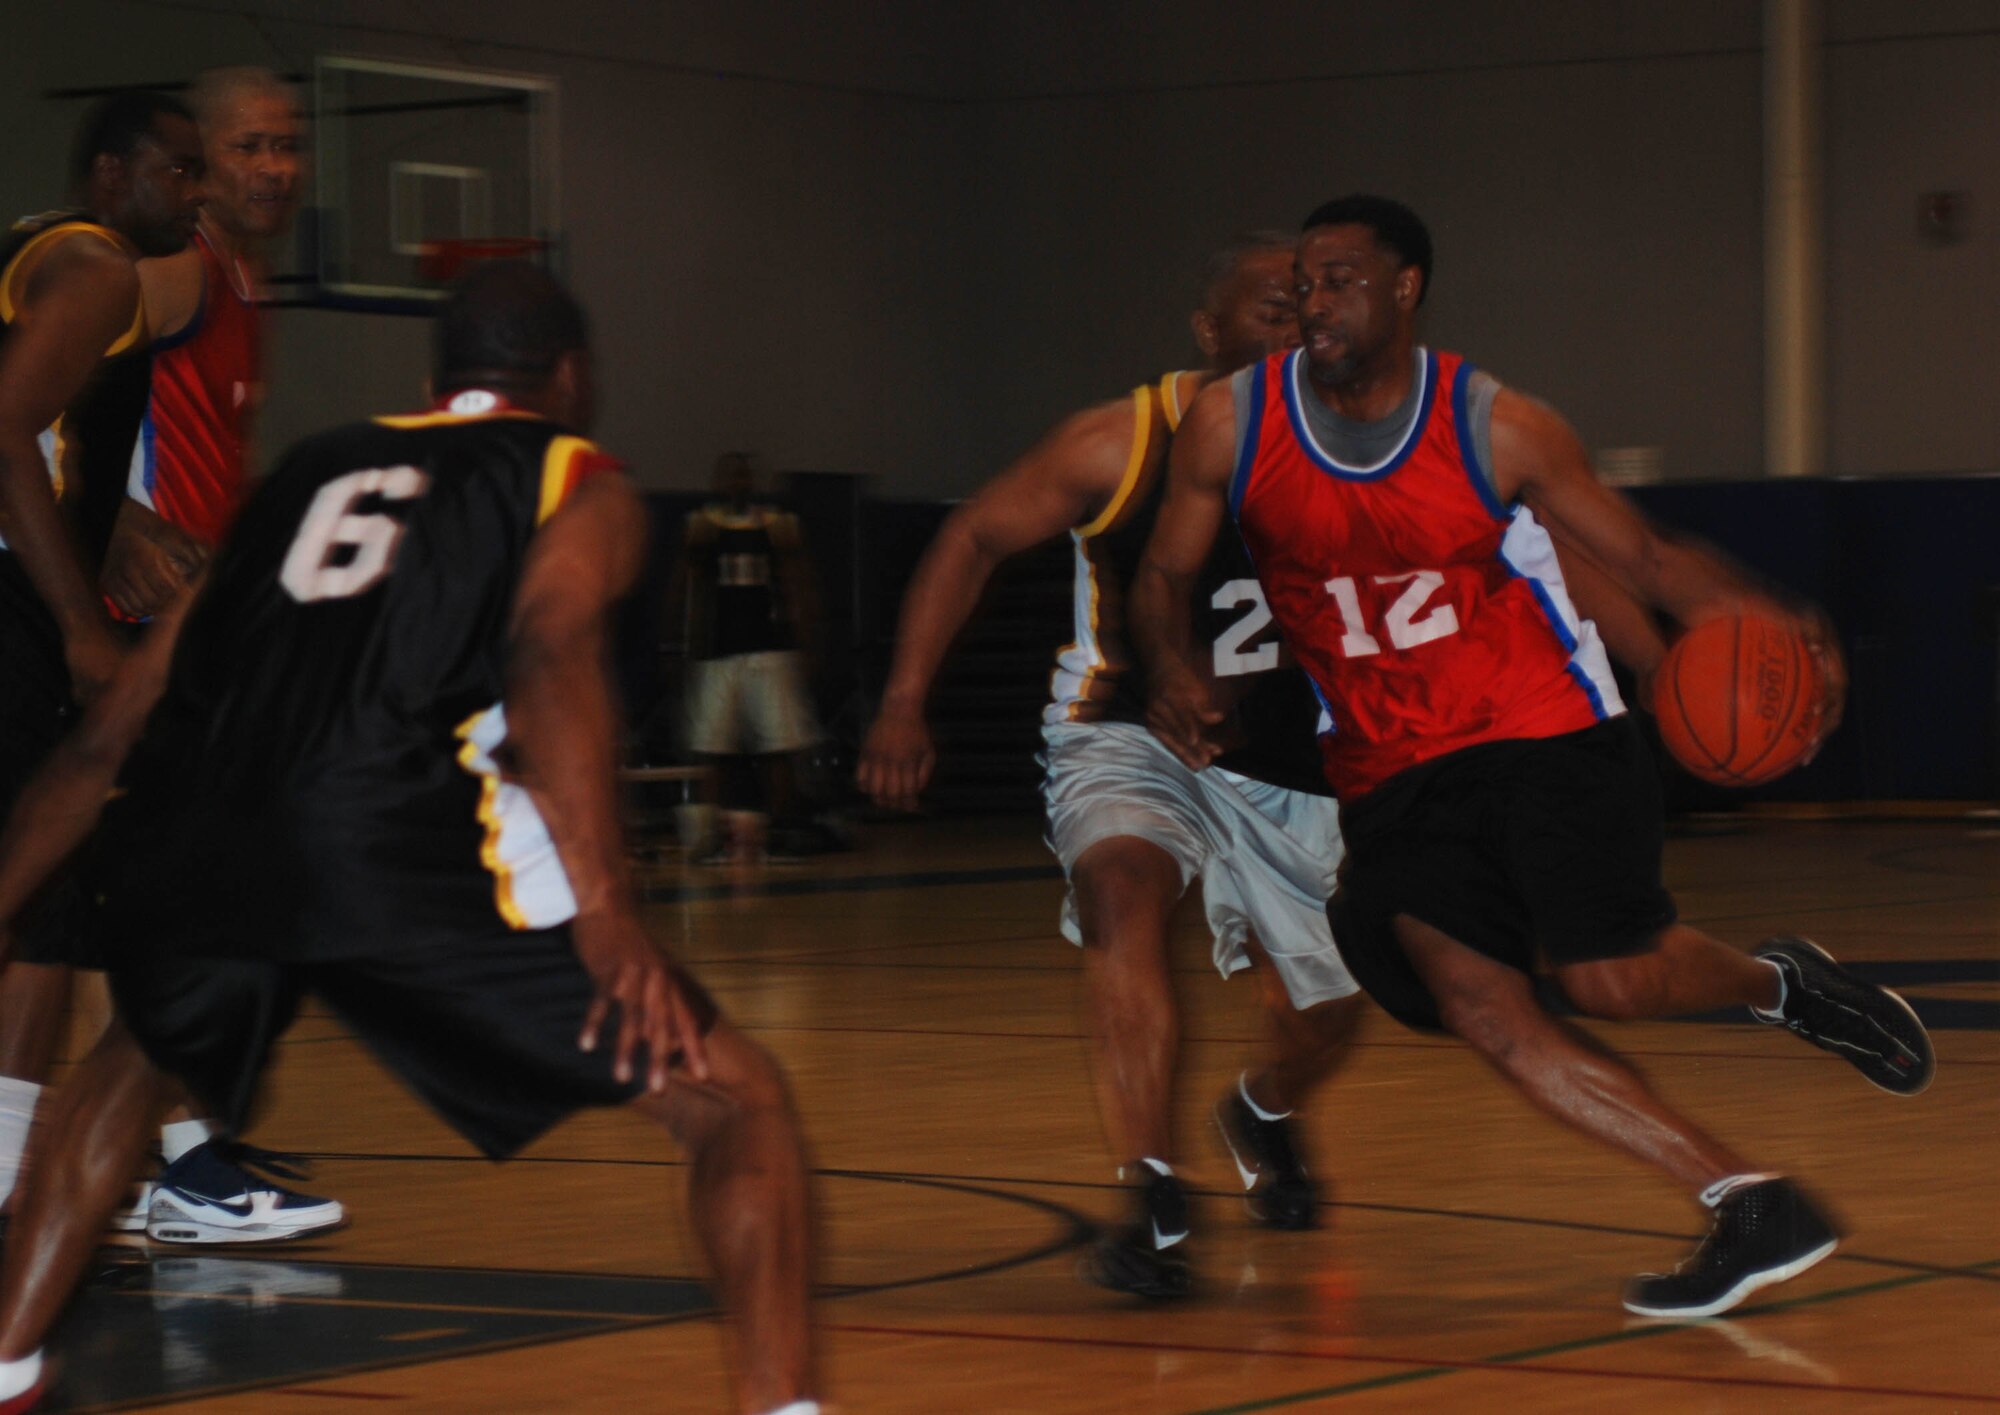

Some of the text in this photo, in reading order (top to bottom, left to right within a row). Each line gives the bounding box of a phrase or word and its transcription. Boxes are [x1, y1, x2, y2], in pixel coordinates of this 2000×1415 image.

[278, 464, 430, 604] 6
[1211, 578, 1279, 677] 2
[1324, 569, 1460, 658] 12
